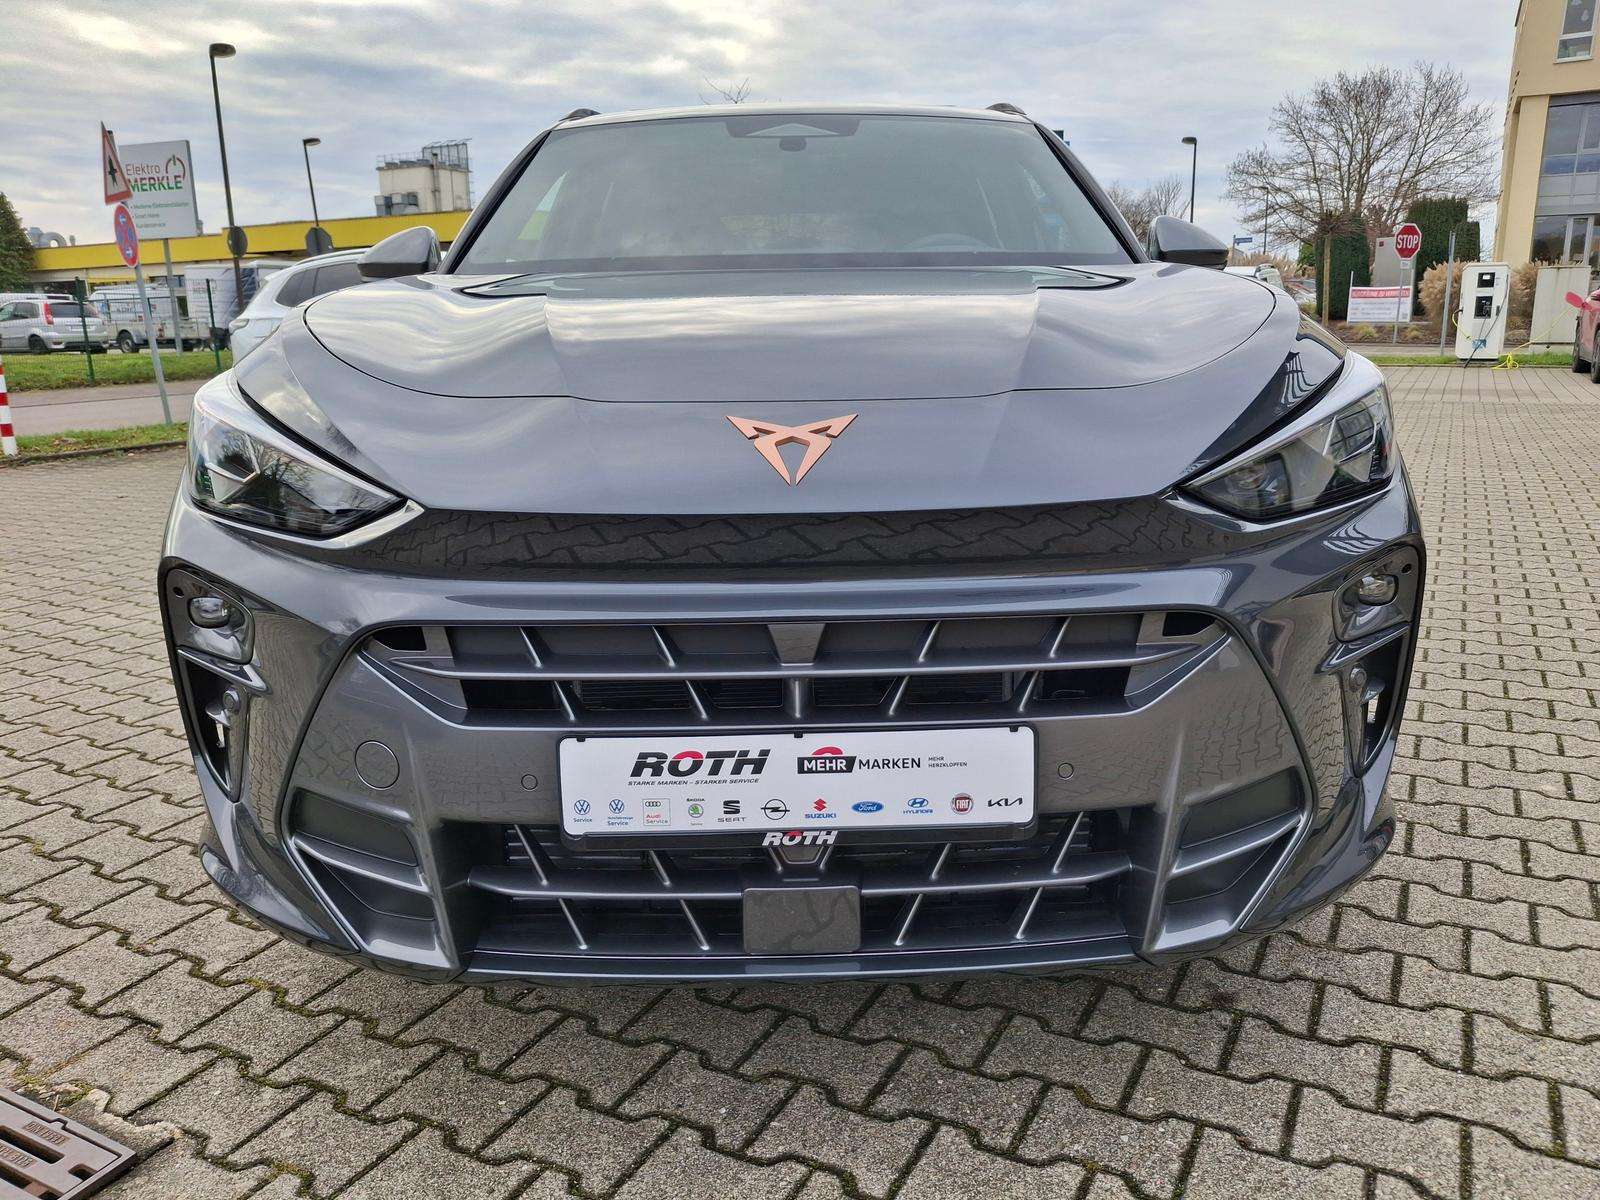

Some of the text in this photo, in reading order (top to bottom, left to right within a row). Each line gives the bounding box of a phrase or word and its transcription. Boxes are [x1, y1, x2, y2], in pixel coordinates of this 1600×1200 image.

[125, 163, 160, 176] Elektro
[128, 175, 183, 192] MERKLE
[1396, 234, 1419, 249] STOP
[630, 749, 771, 777] ROTH
[803, 757, 921, 771] MEHR MARKEN
[858, 803, 878, 811] Ford
[956, 799, 970, 810] FIAT
[762, 830, 838, 846] ROTH
